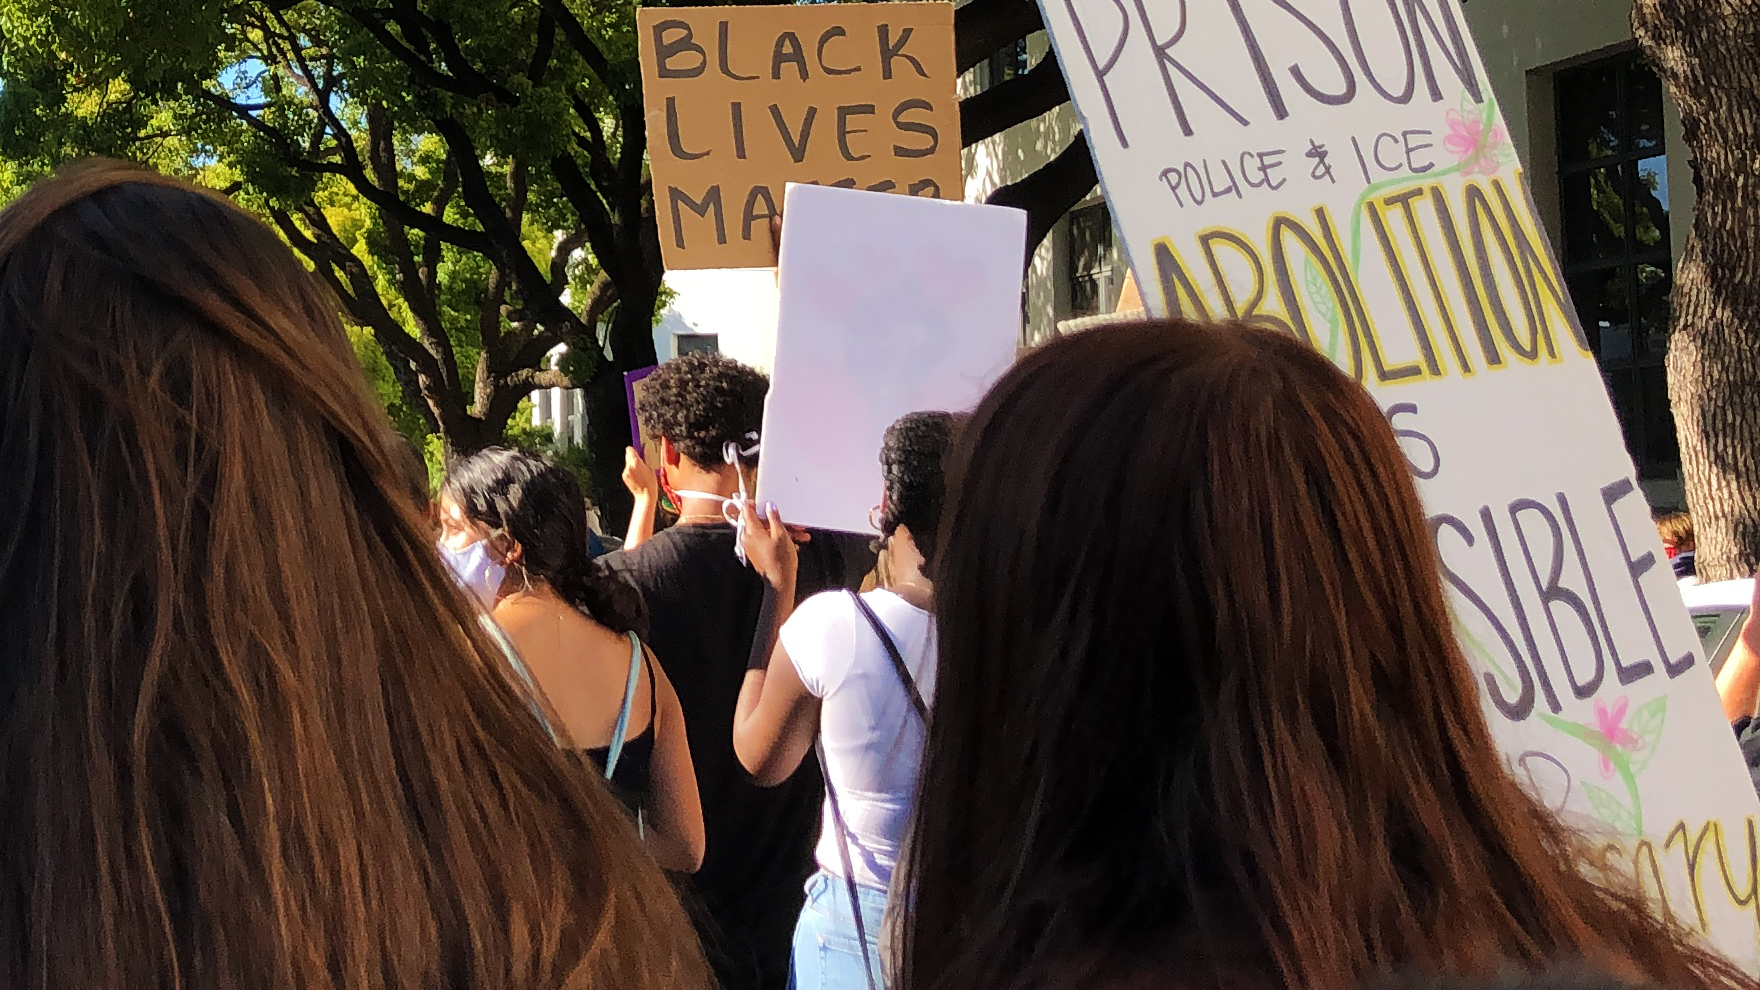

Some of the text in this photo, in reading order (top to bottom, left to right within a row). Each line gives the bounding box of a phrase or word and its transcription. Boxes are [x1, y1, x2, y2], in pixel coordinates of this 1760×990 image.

[652, 19, 931, 82] BLACK
[665, 96, 939, 163] LIVES
[1160, 148, 1287, 209] POLICE
[1352, 129, 1436, 185] ICE
[1152, 175, 1592, 384] ABOLITION
[1428, 476, 1696, 722] SIBLE
